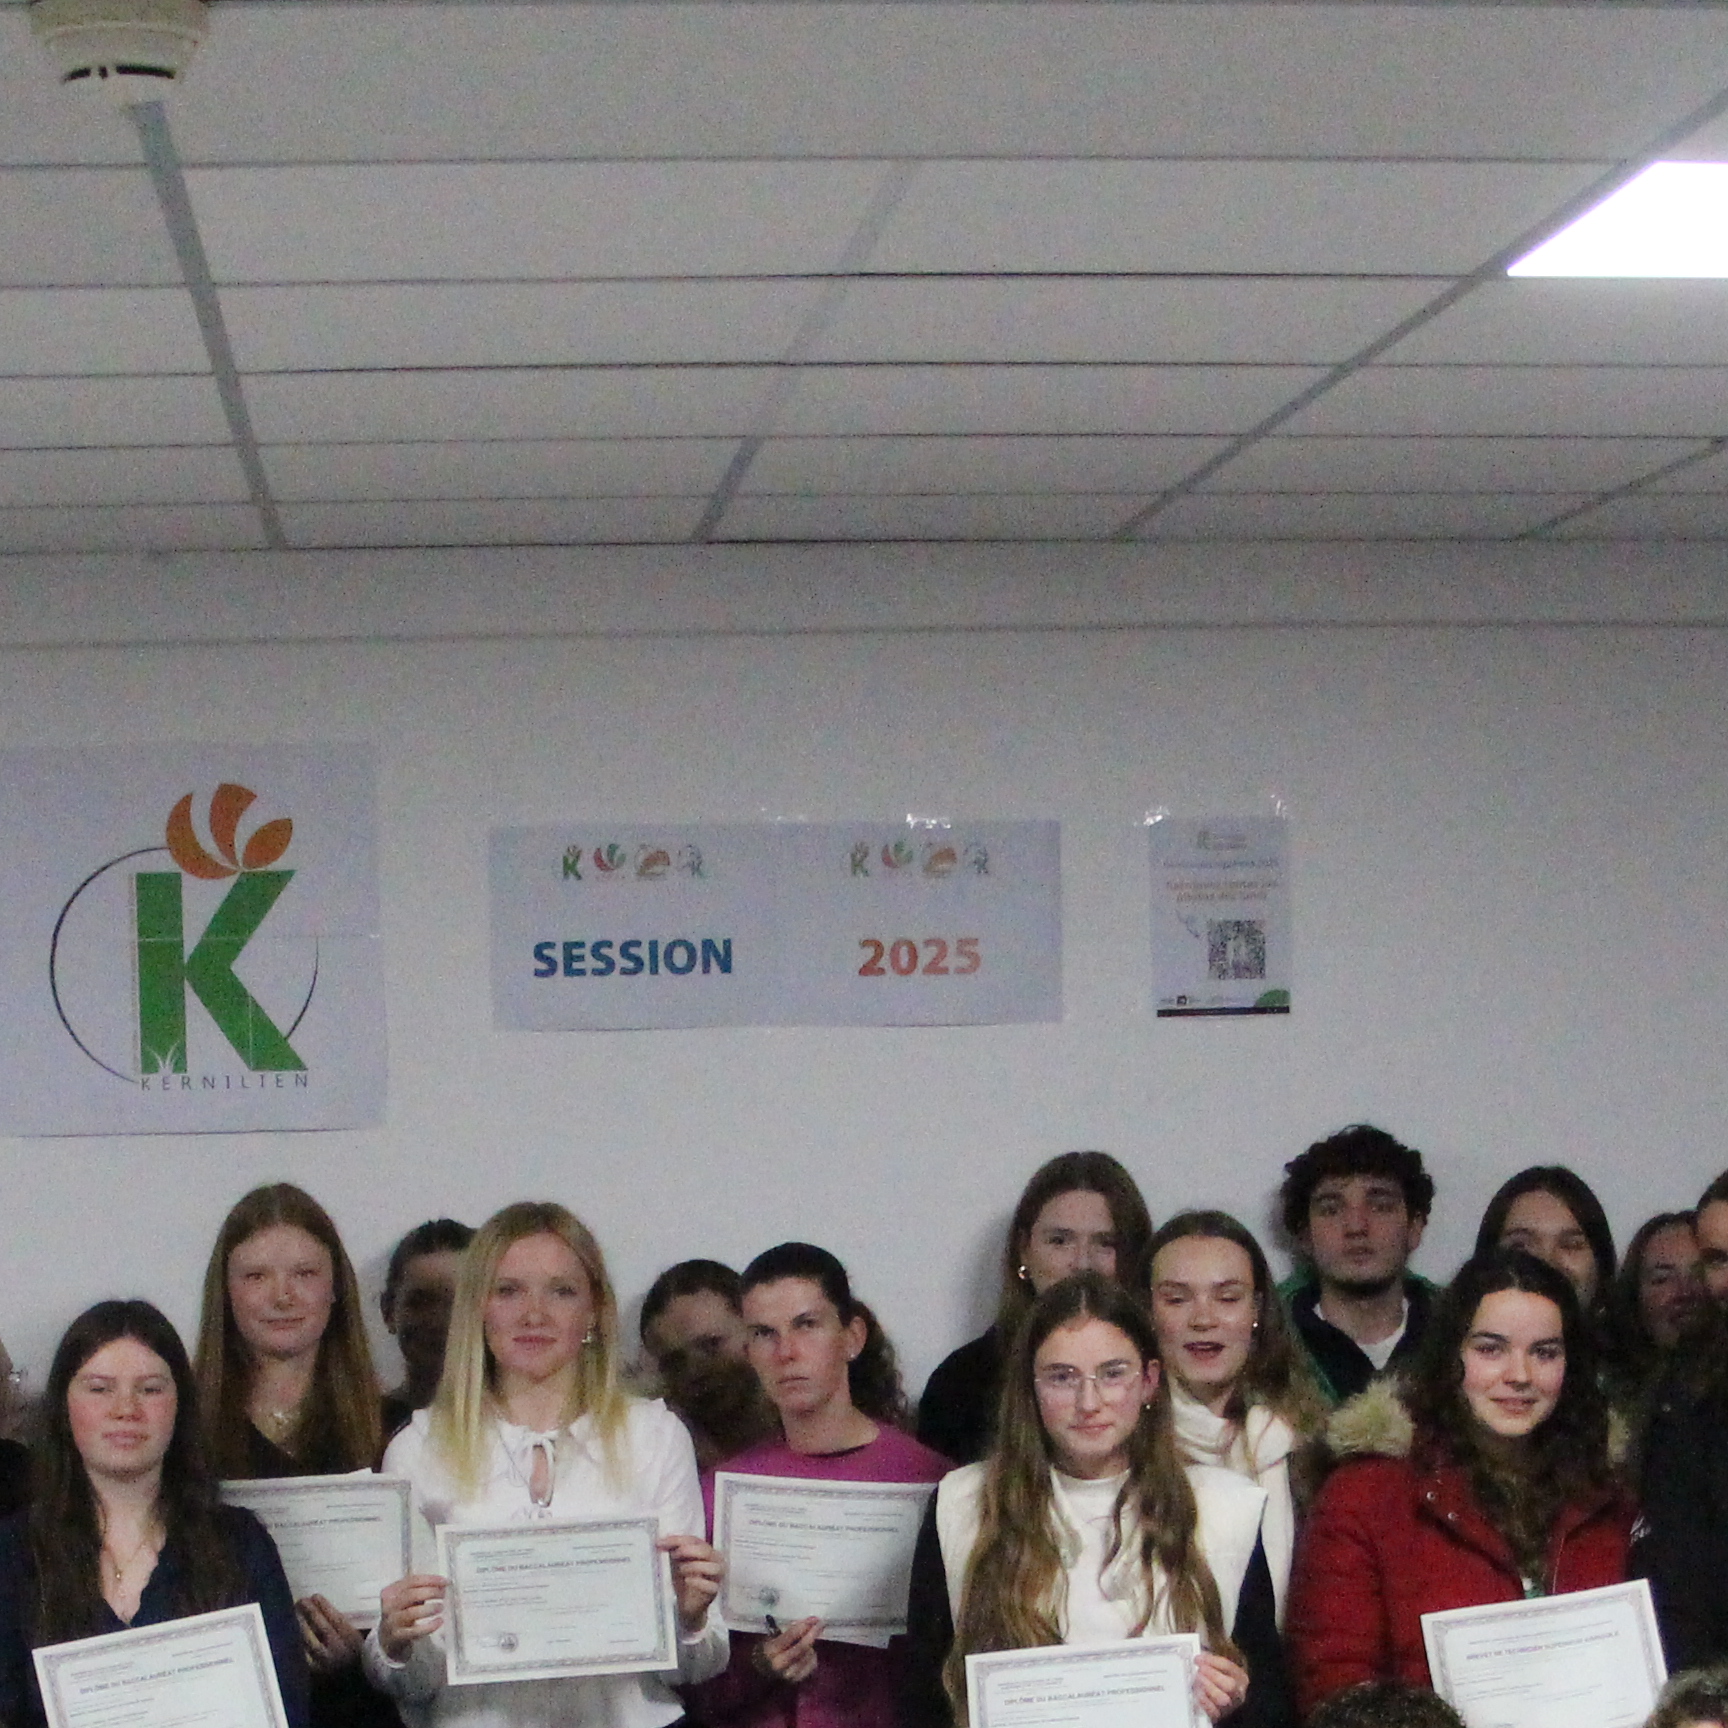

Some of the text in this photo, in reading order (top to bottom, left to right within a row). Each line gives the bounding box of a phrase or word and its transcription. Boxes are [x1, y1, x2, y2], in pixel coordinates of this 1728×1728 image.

[533, 937, 982, 978] SESSION 2025
[141, 1074, 309, 1091] KERNILIEN
